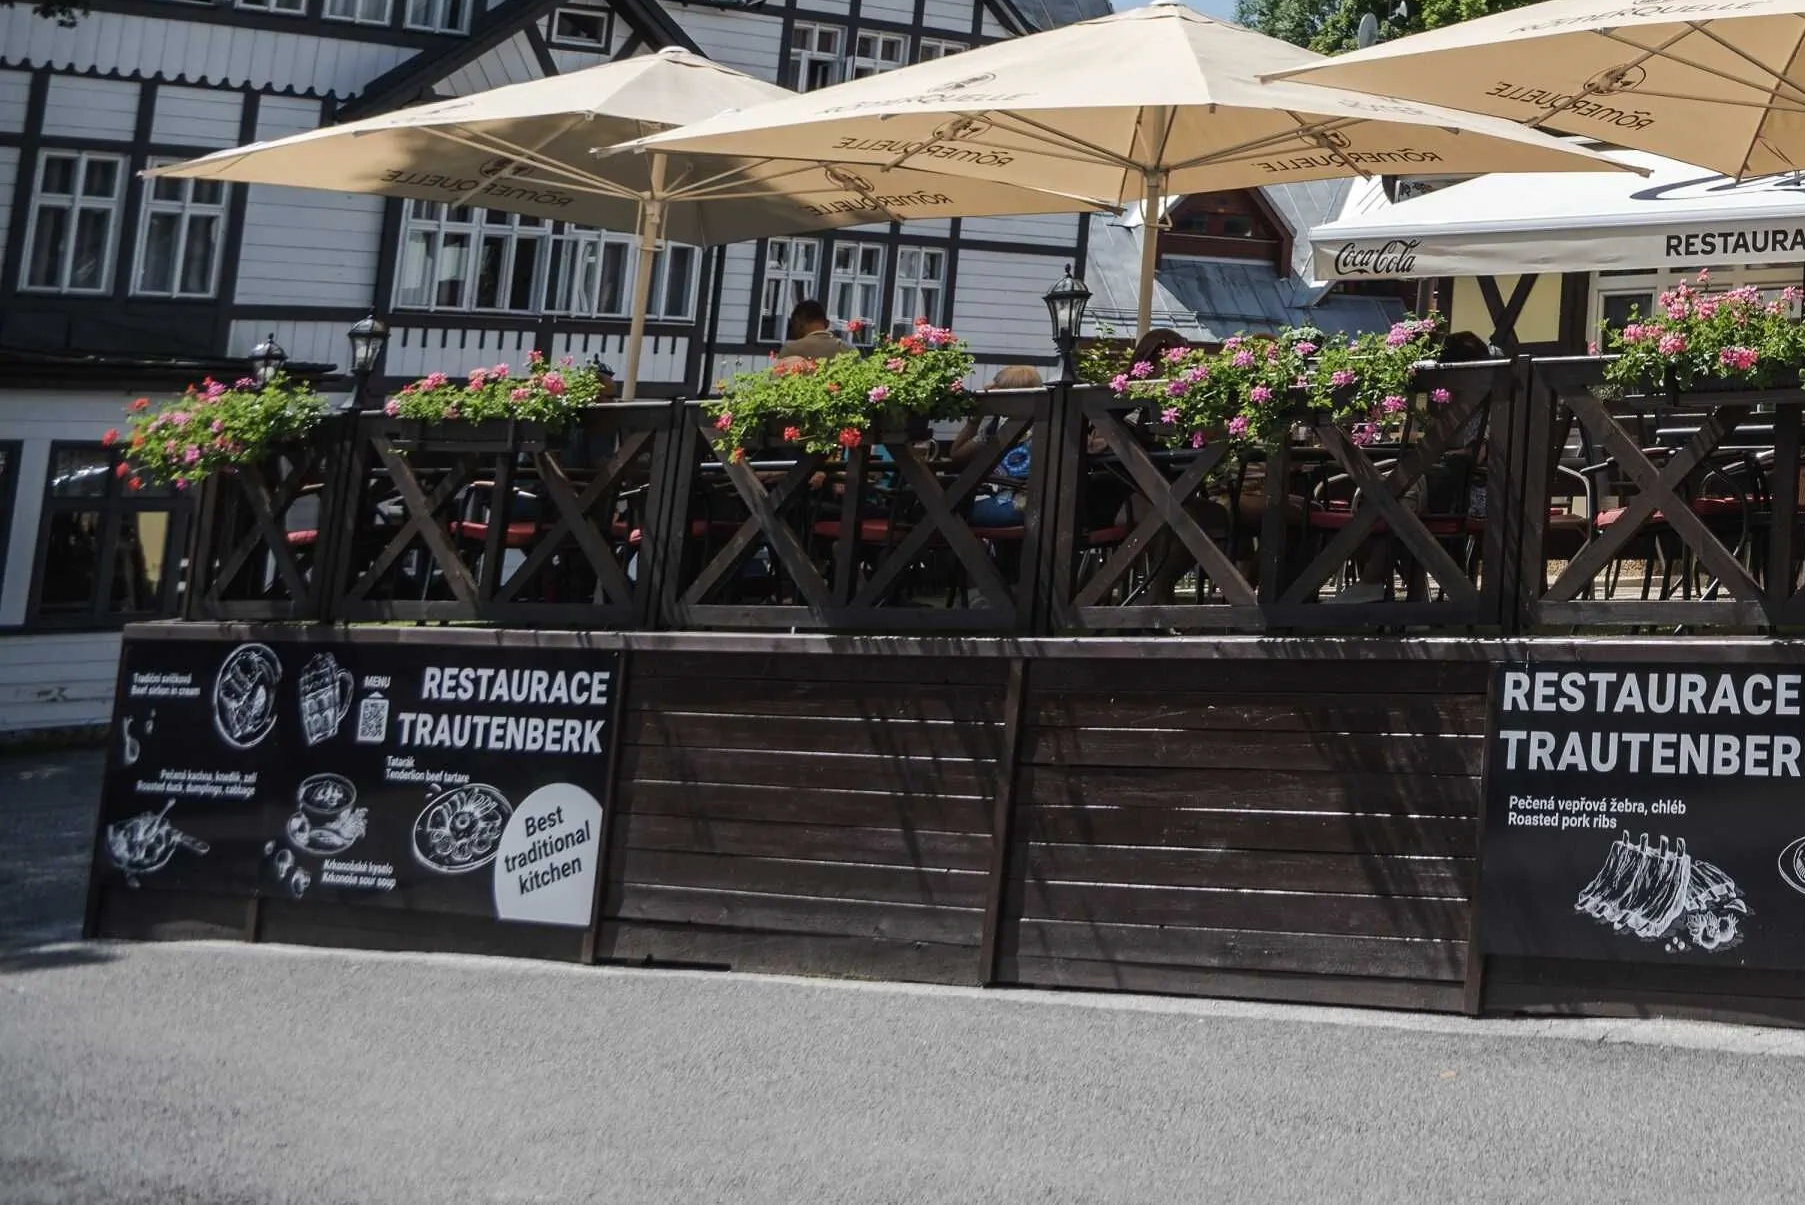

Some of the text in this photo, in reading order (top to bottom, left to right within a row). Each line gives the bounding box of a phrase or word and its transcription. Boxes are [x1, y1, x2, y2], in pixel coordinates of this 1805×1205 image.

[1334, 239, 1422, 276] Coca-Cola
[363, 675, 391, 689] MENU
[422, 666, 610, 706] RESTAURACE
[1502, 671, 1802, 716] RESTAURACE
[398, 711, 606, 754] TRAUTENBERK
[525, 805, 564, 838] Best
[1508, 811, 1618, 830] Roasted pork ribs
[1509, 795, 1687, 816] Pečená vepřová žebra, chléb
[504, 819, 591, 873] traditional
[518, 857, 582, 895] kitchen
